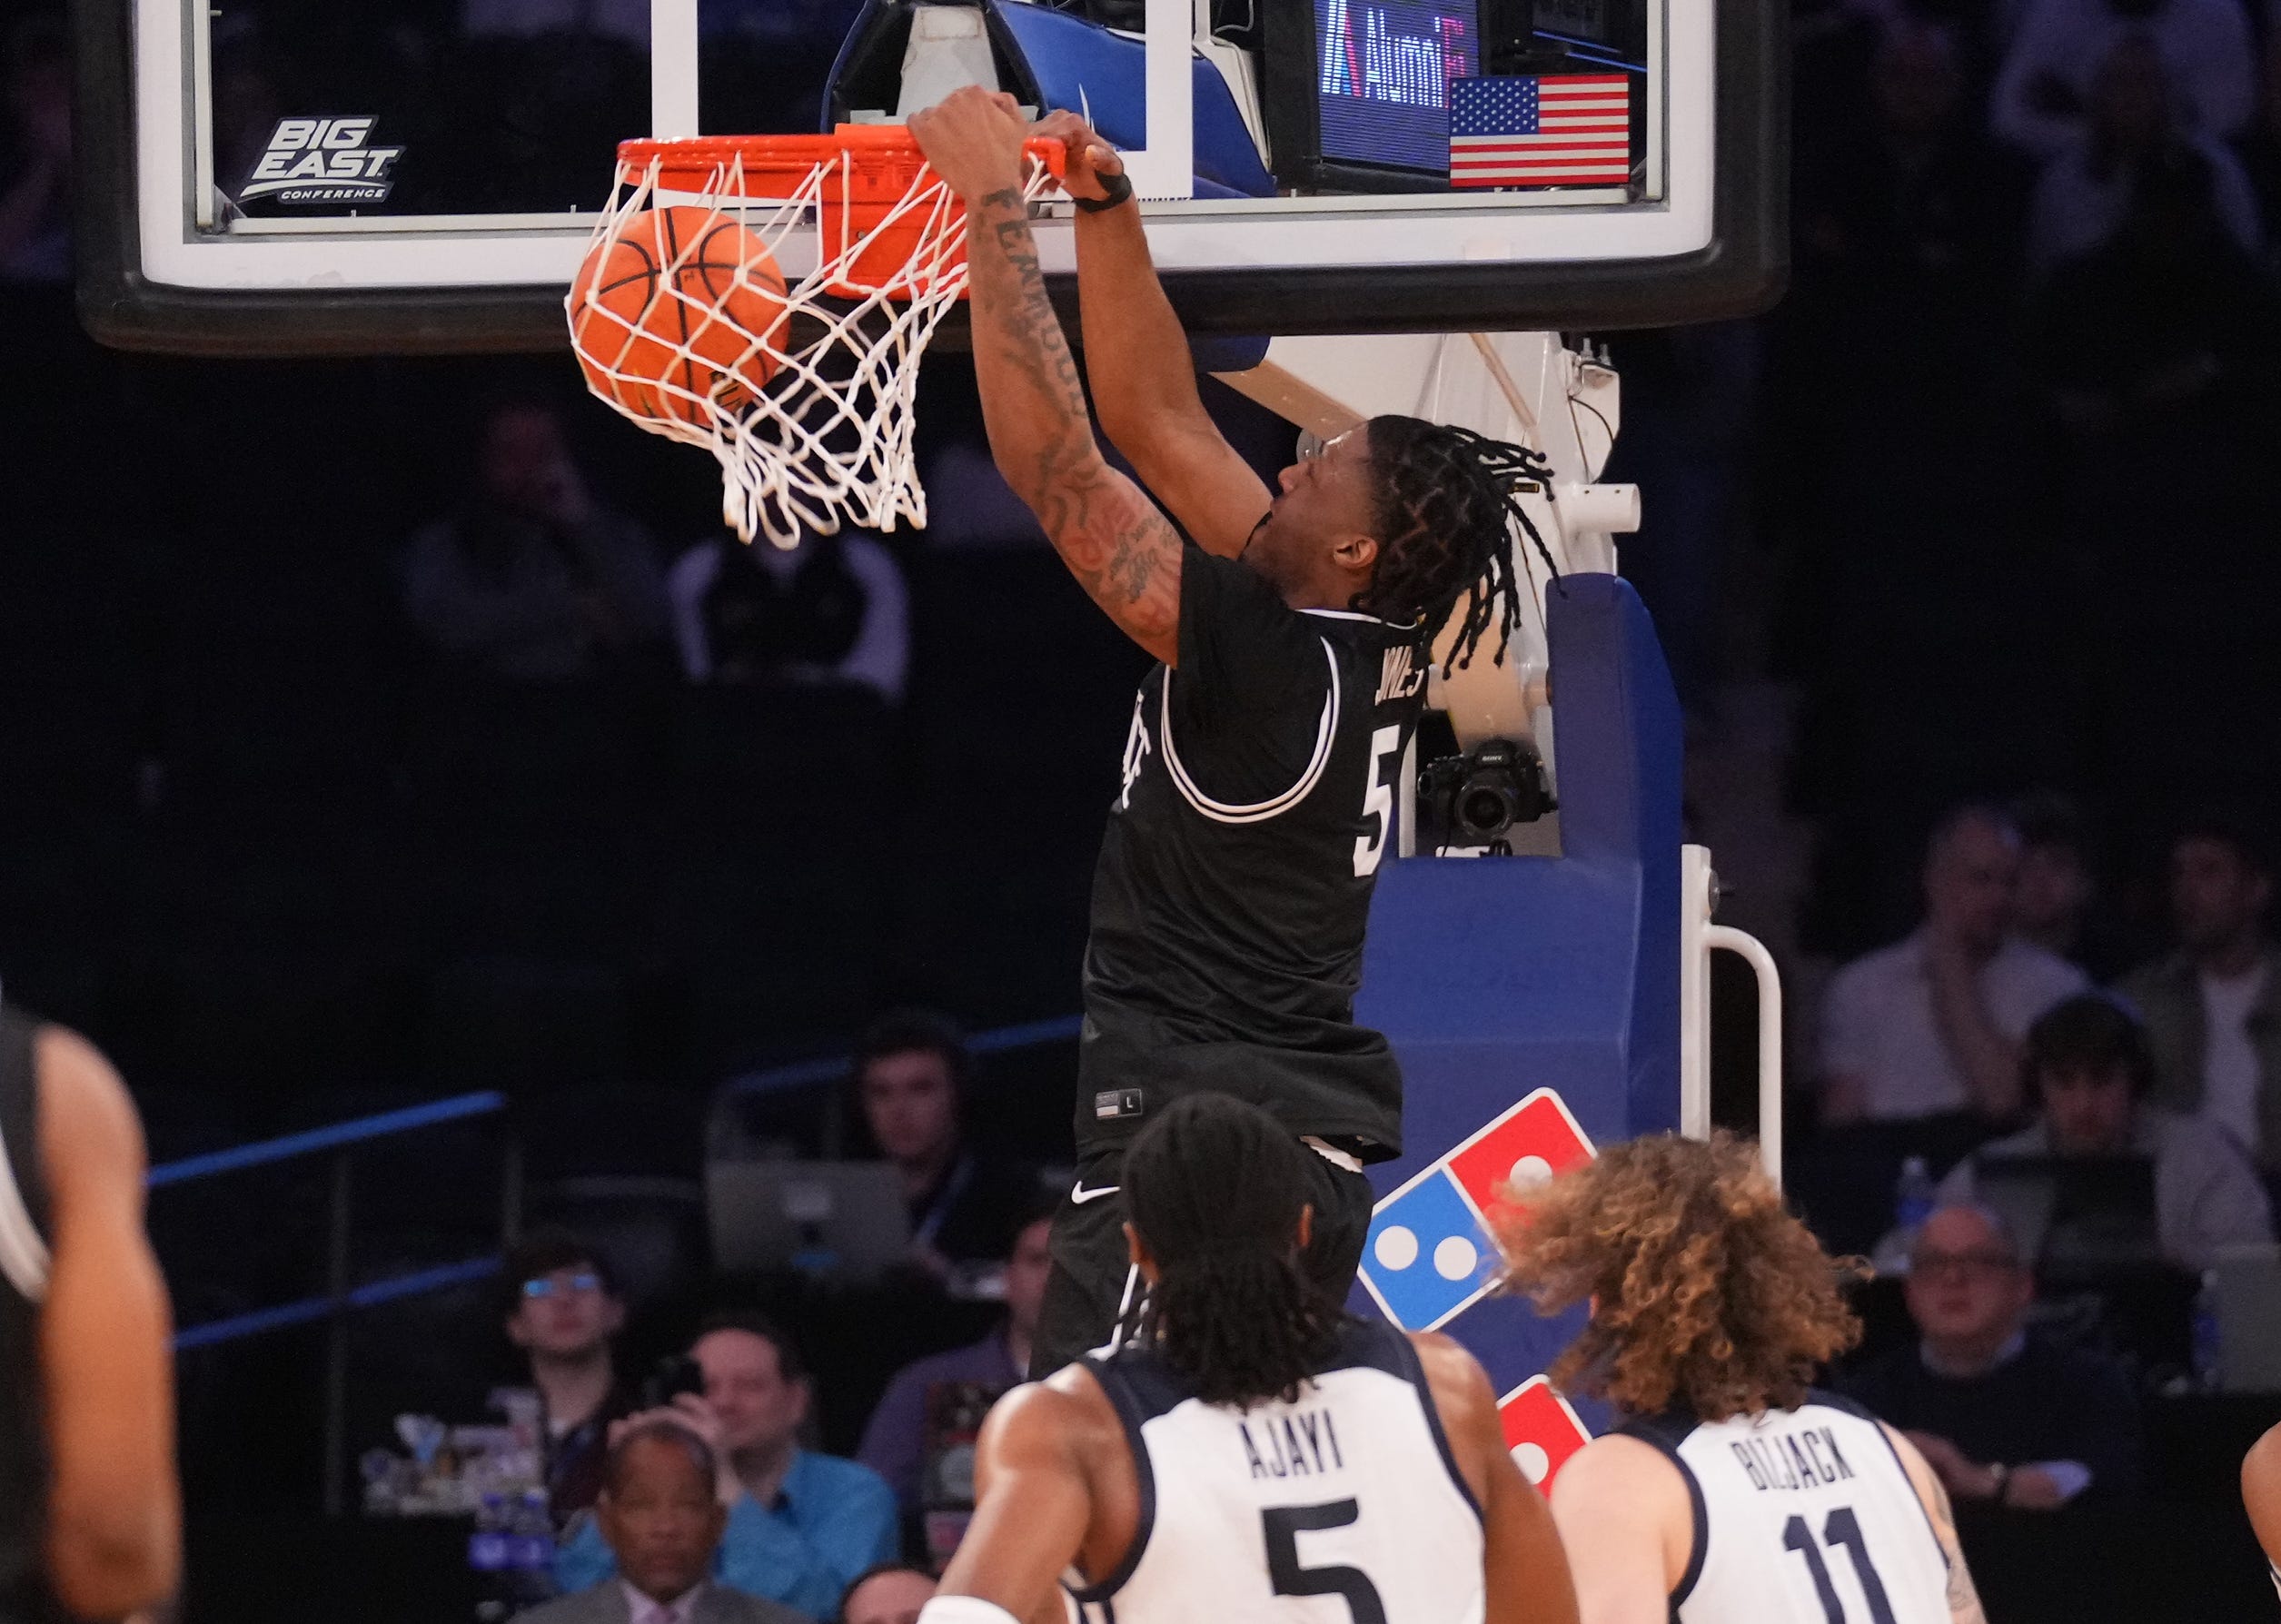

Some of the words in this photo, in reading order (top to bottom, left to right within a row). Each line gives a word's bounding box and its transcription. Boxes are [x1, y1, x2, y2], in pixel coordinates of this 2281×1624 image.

[267, 118, 372, 151] BIG
[251, 149, 399, 180] EAST
[281, 188, 386, 200] CONFERENCE
[1354, 725, 1401, 877] 5
[1126, 1096, 1134, 1108] L
[1238, 1409, 1344, 1480] AJAYI
[1260, 1496, 1388, 1624] 5
[1782, 1506, 1897, 1624] 11
